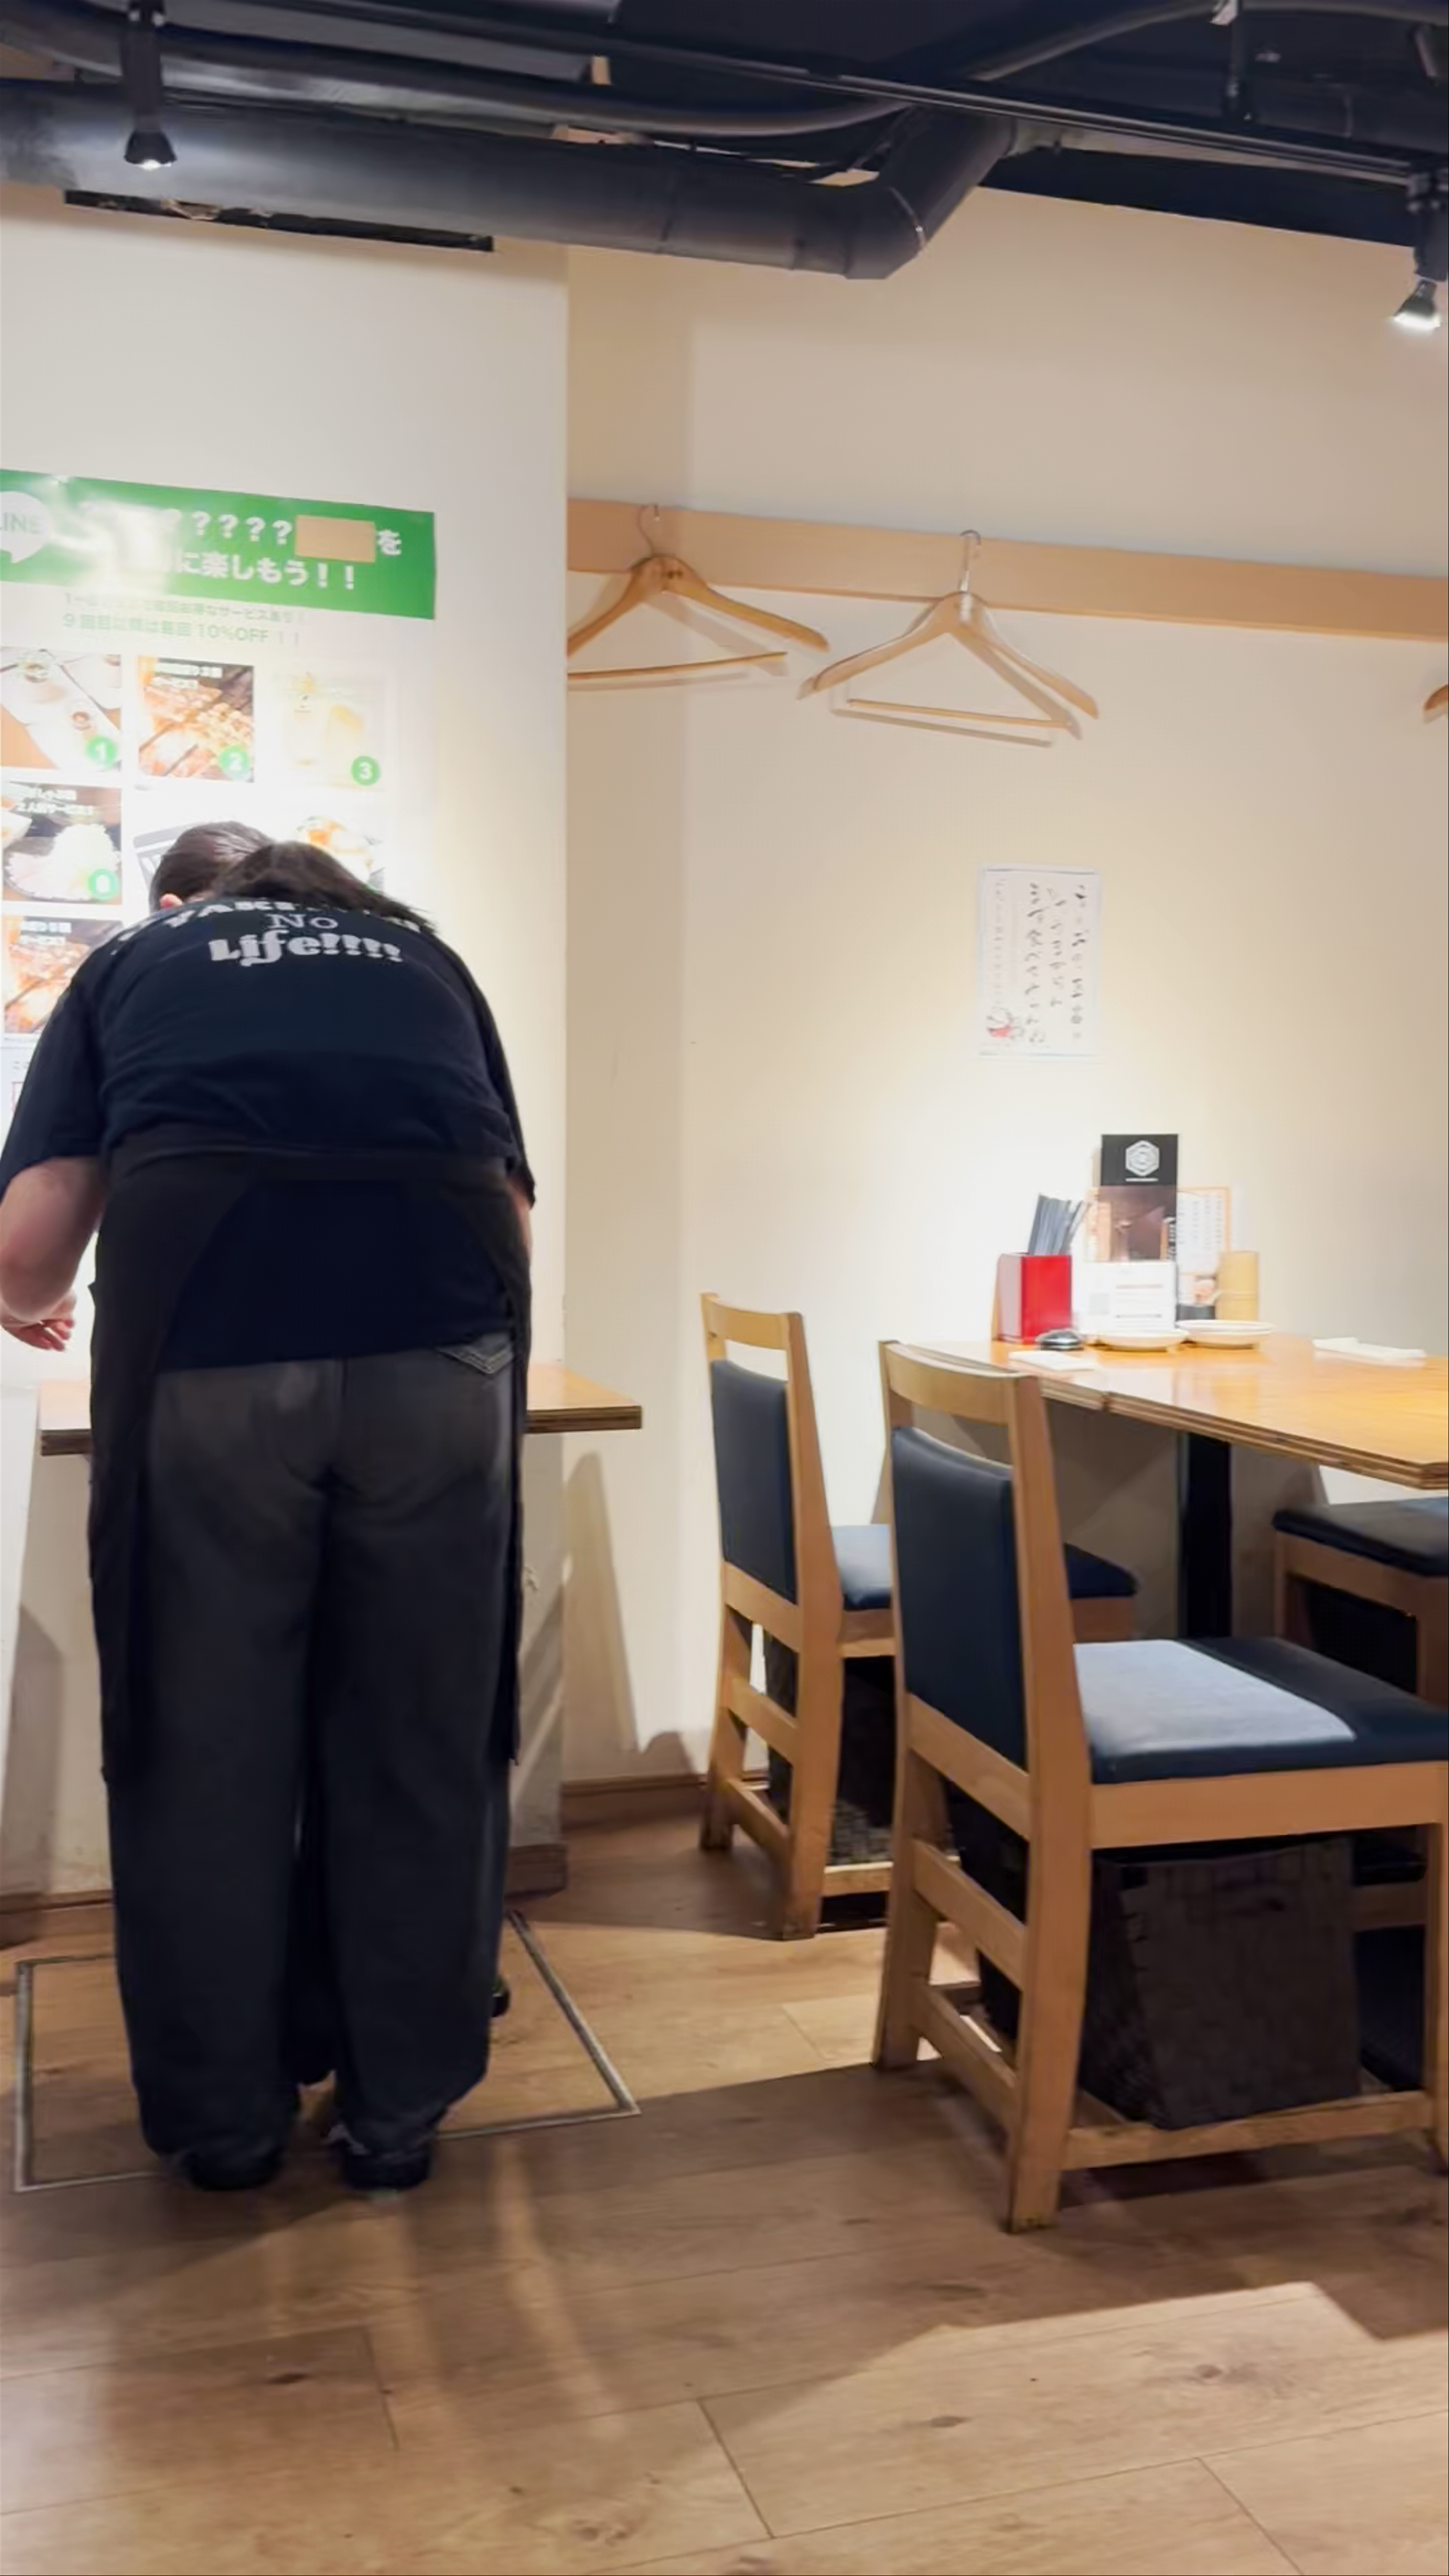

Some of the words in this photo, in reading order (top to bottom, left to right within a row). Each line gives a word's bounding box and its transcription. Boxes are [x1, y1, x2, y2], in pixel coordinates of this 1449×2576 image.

[0, 511, 43, 535] INE
[377, 529, 402, 557] を
[357, 761, 374, 780] 3
